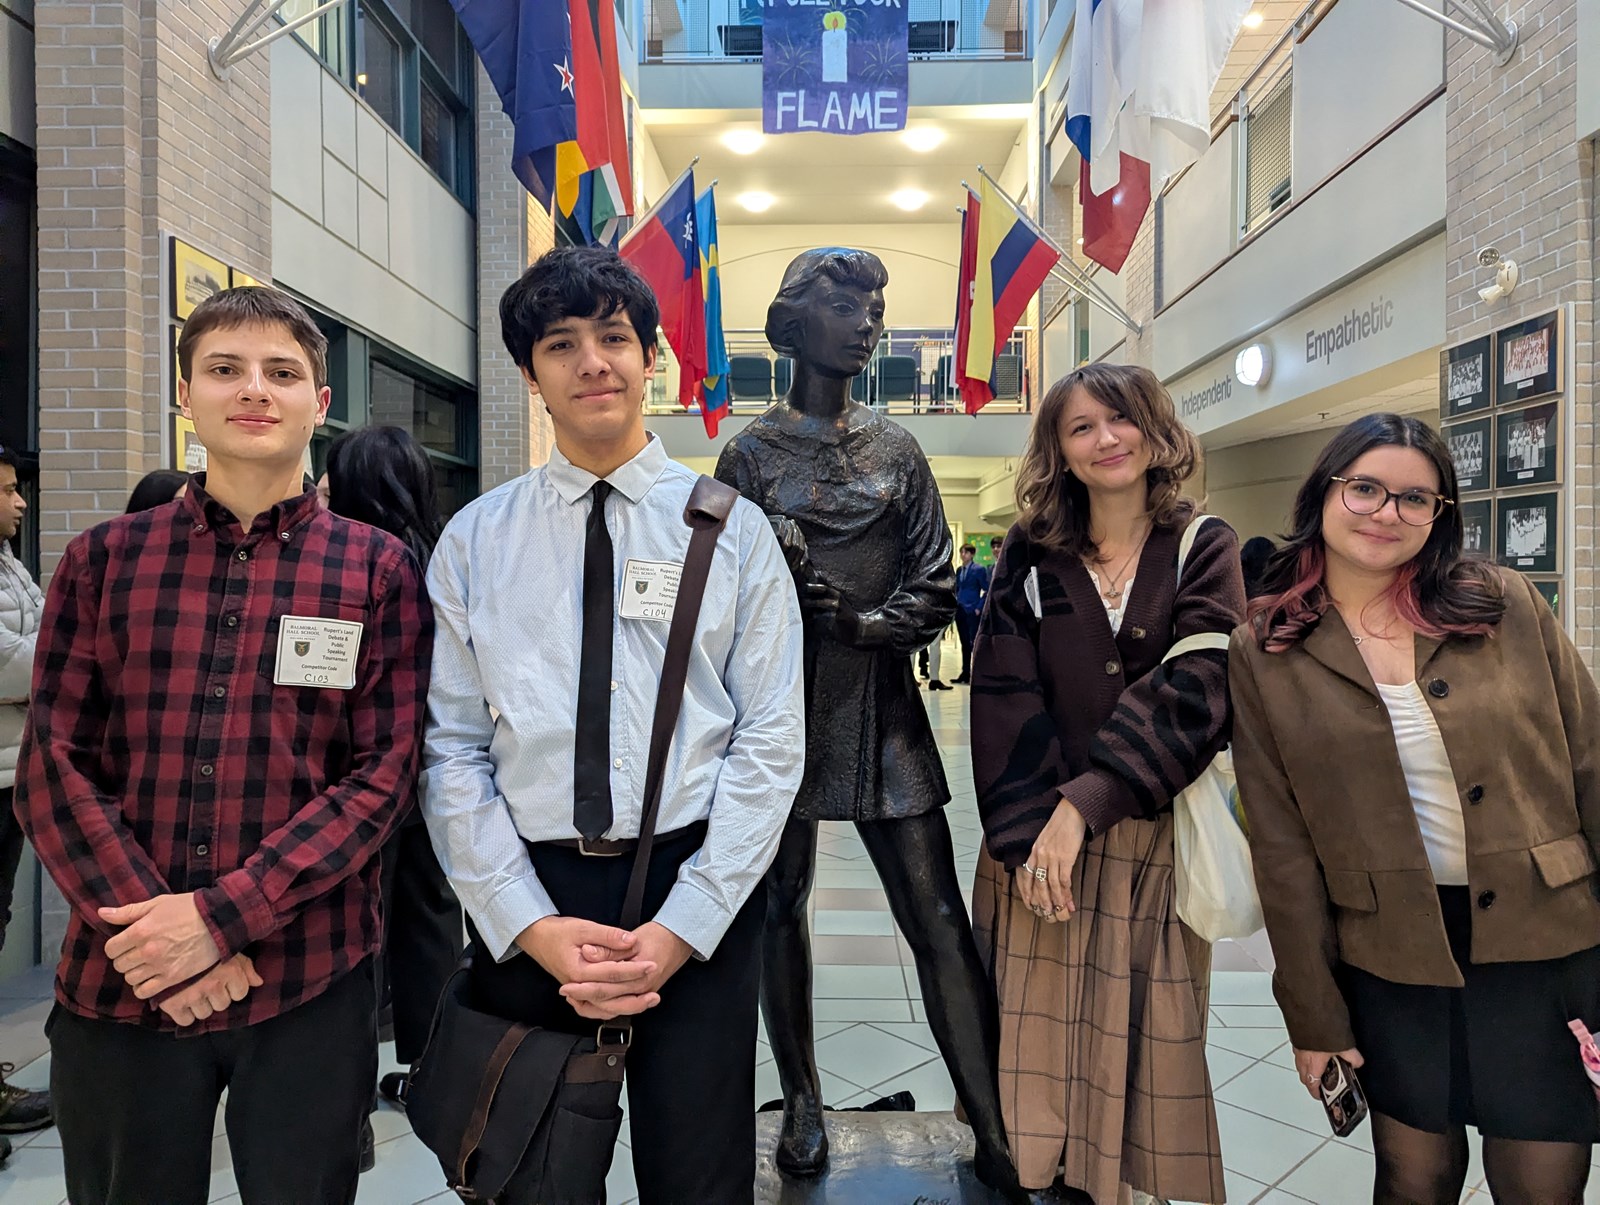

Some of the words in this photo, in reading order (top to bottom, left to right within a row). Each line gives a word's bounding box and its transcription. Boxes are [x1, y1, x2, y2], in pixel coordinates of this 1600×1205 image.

[777, 90, 898, 130] FLAME
[1306, 296, 1394, 365] Empathetic
[1181, 375, 1232, 420] Independent
[643, 609, 667, 618] C104
[304, 673, 329, 683] C103
